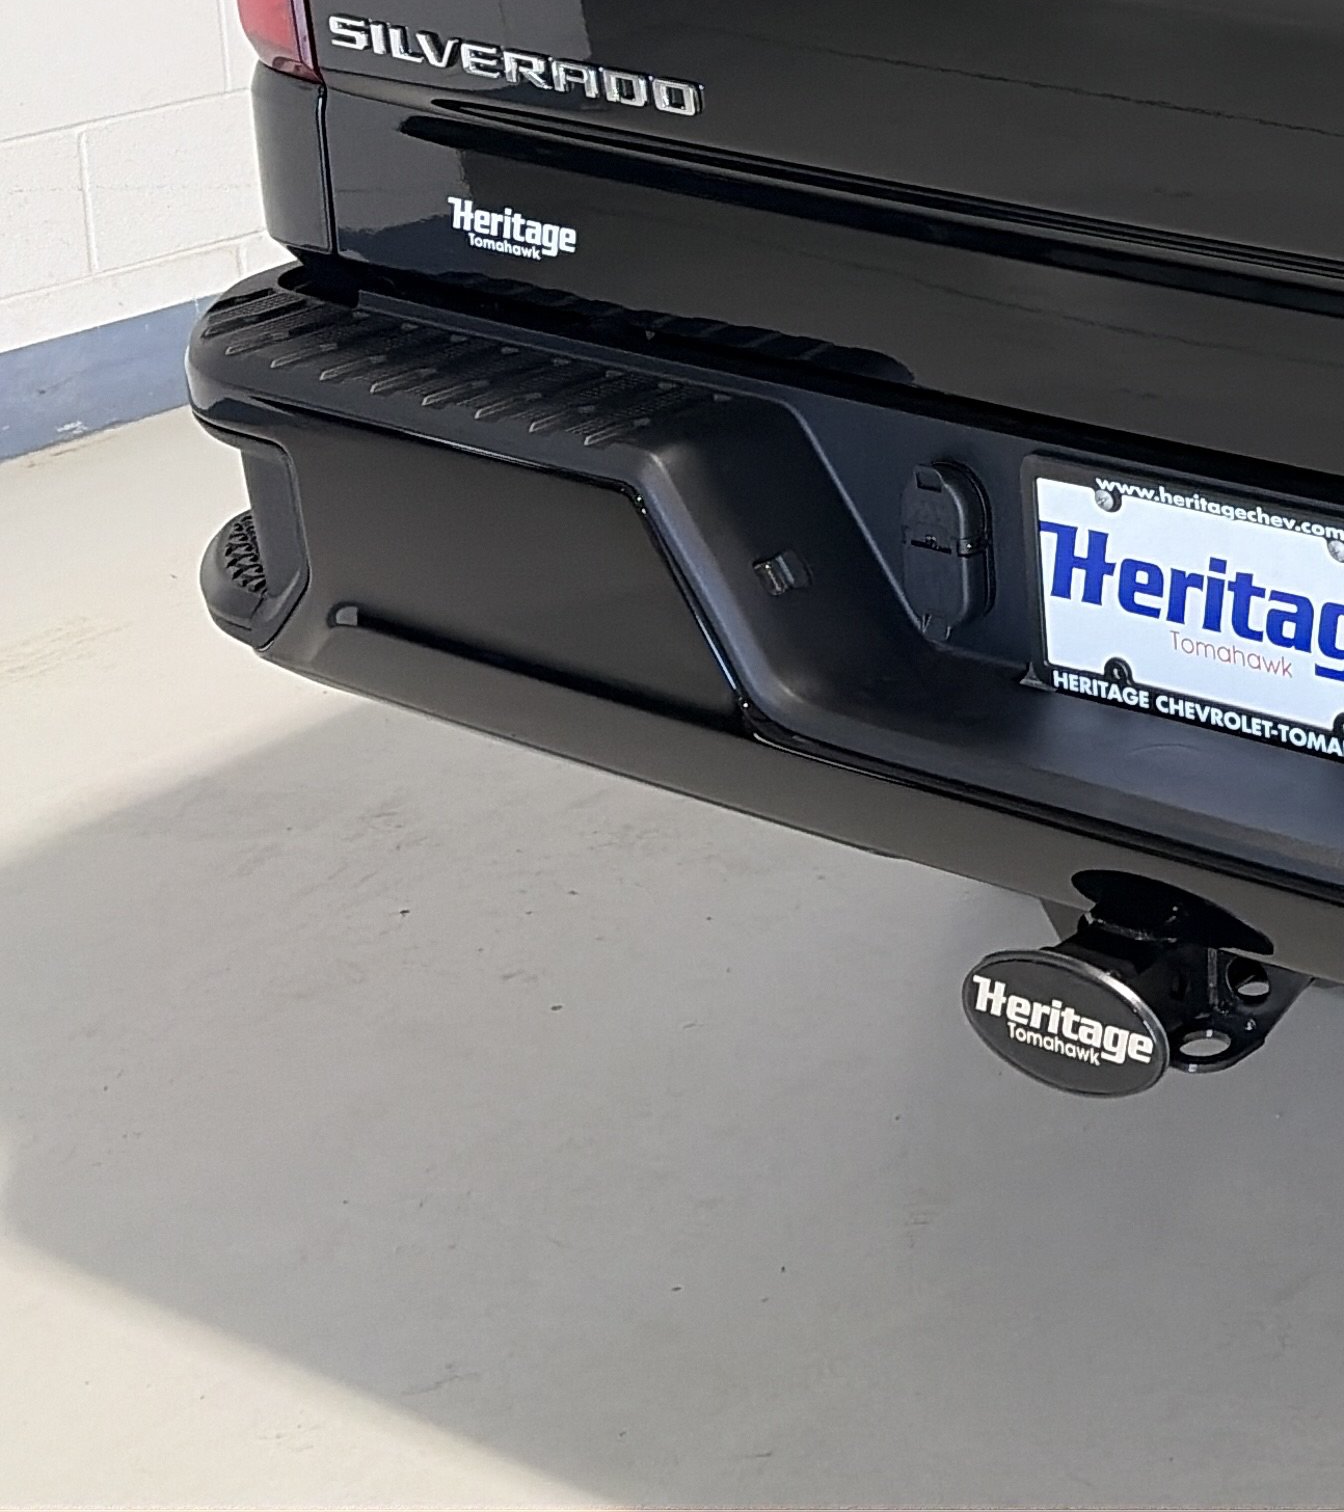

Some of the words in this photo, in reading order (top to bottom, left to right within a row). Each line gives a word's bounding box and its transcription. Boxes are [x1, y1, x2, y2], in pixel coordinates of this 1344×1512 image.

[327, 13, 704, 117] SILVERADO
[447, 196, 577, 258] Heritage
[467, 232, 543, 261] Tomahawk
[1168, 630, 1294, 679] Tomahawk
[1052, 669, 1150, 710] HERITAGE
[972, 974, 1154, 1065] Heritage
[1007, 1021, 1101, 1067] Tomahawk
